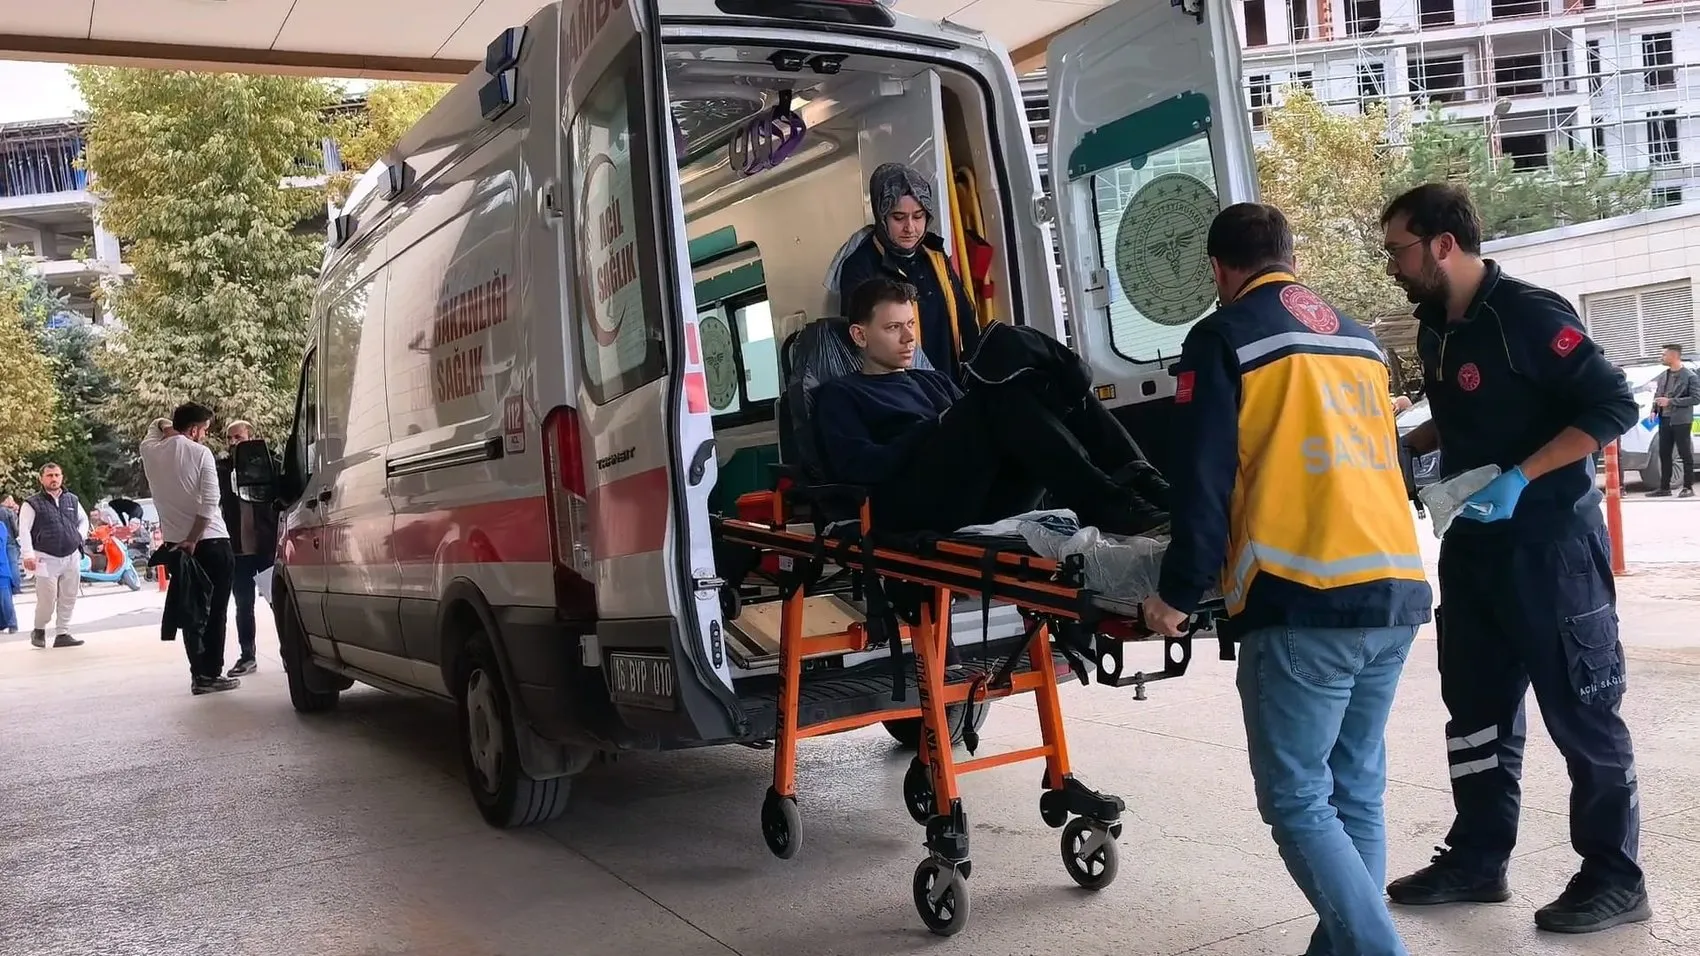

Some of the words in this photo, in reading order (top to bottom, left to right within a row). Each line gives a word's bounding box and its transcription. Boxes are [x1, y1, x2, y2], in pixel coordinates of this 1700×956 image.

[566, 0, 622, 64] AMB
[599, 195, 624, 251] ACİL
[597, 241, 637, 304] SAĞLIK
[436, 345, 485, 403] SAĞLIK
[507, 402, 521, 430] 112
[1302, 424, 1394, 475] SAĞLI
[629, 660, 647, 693] BYP
[653, 661, 672, 697] 010
